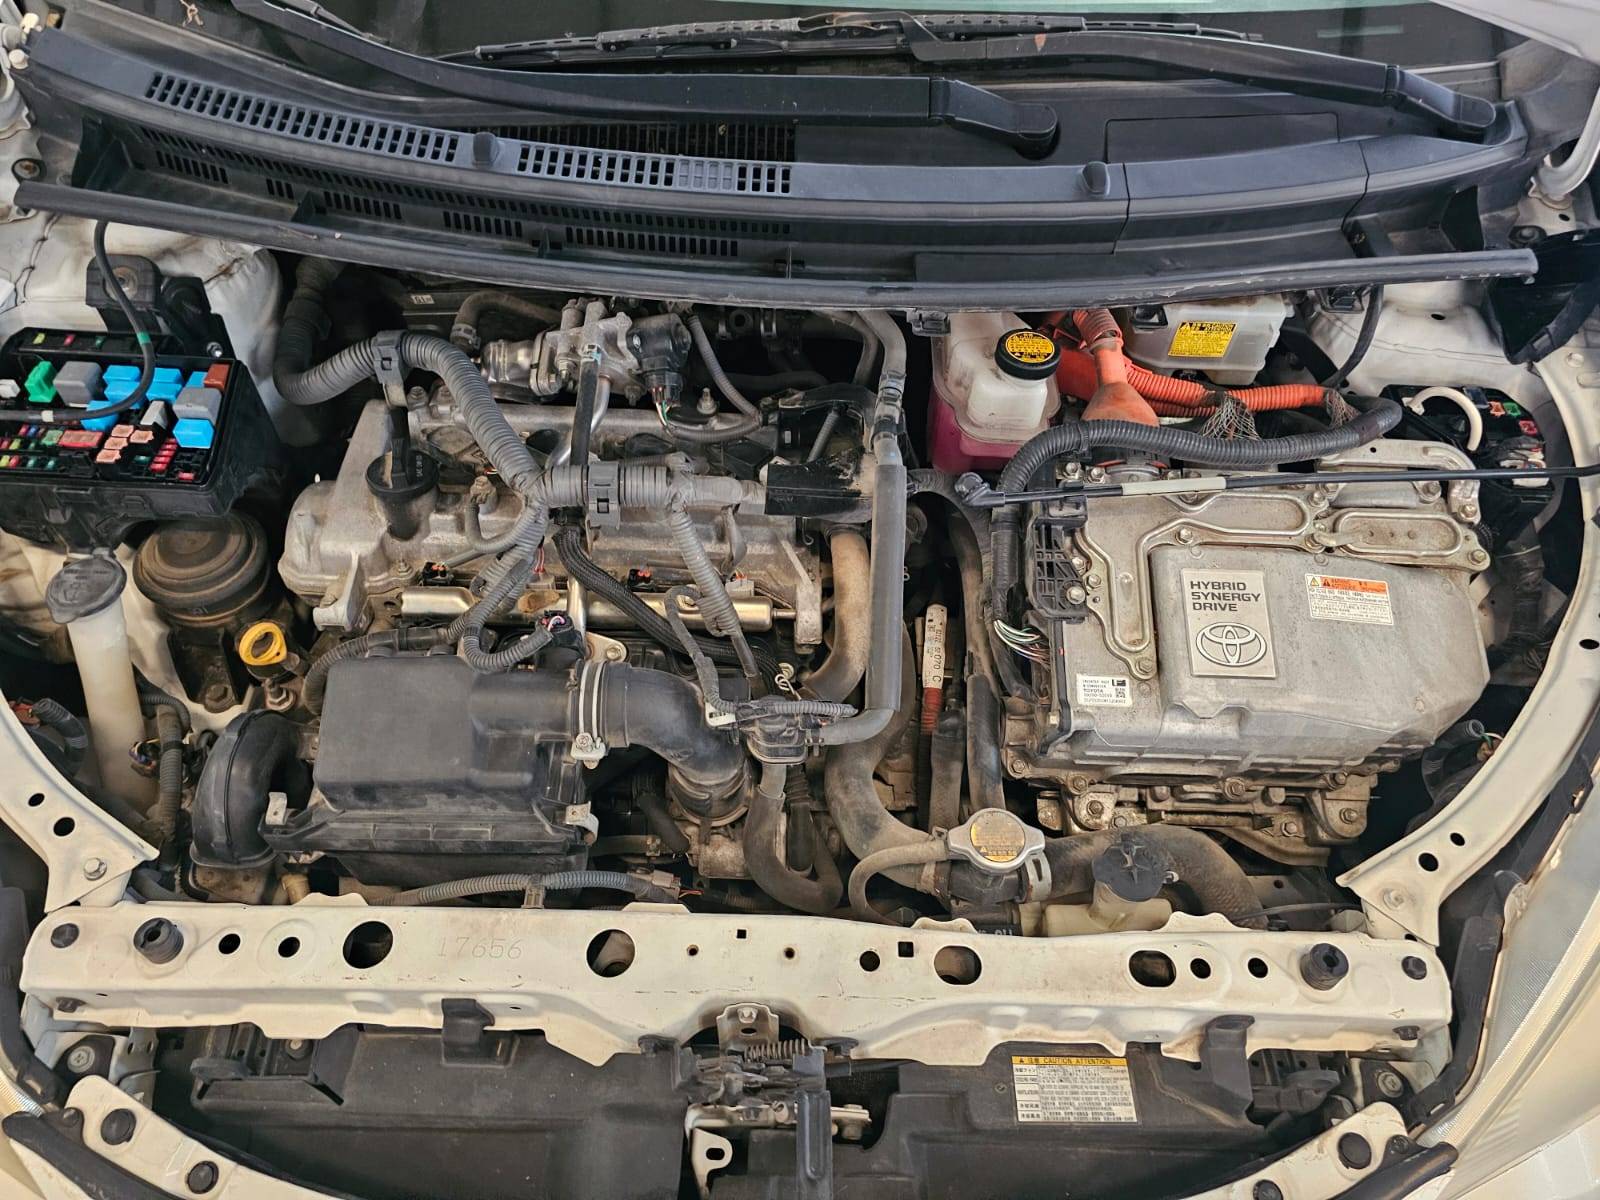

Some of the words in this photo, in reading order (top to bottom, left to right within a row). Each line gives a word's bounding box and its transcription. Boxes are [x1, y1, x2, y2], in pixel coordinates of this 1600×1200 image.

[1190, 581, 1247, 591] HYBRID
[1191, 592, 1261, 602] SYNERGY
[1192, 602, 1238, 612] DRIVE
